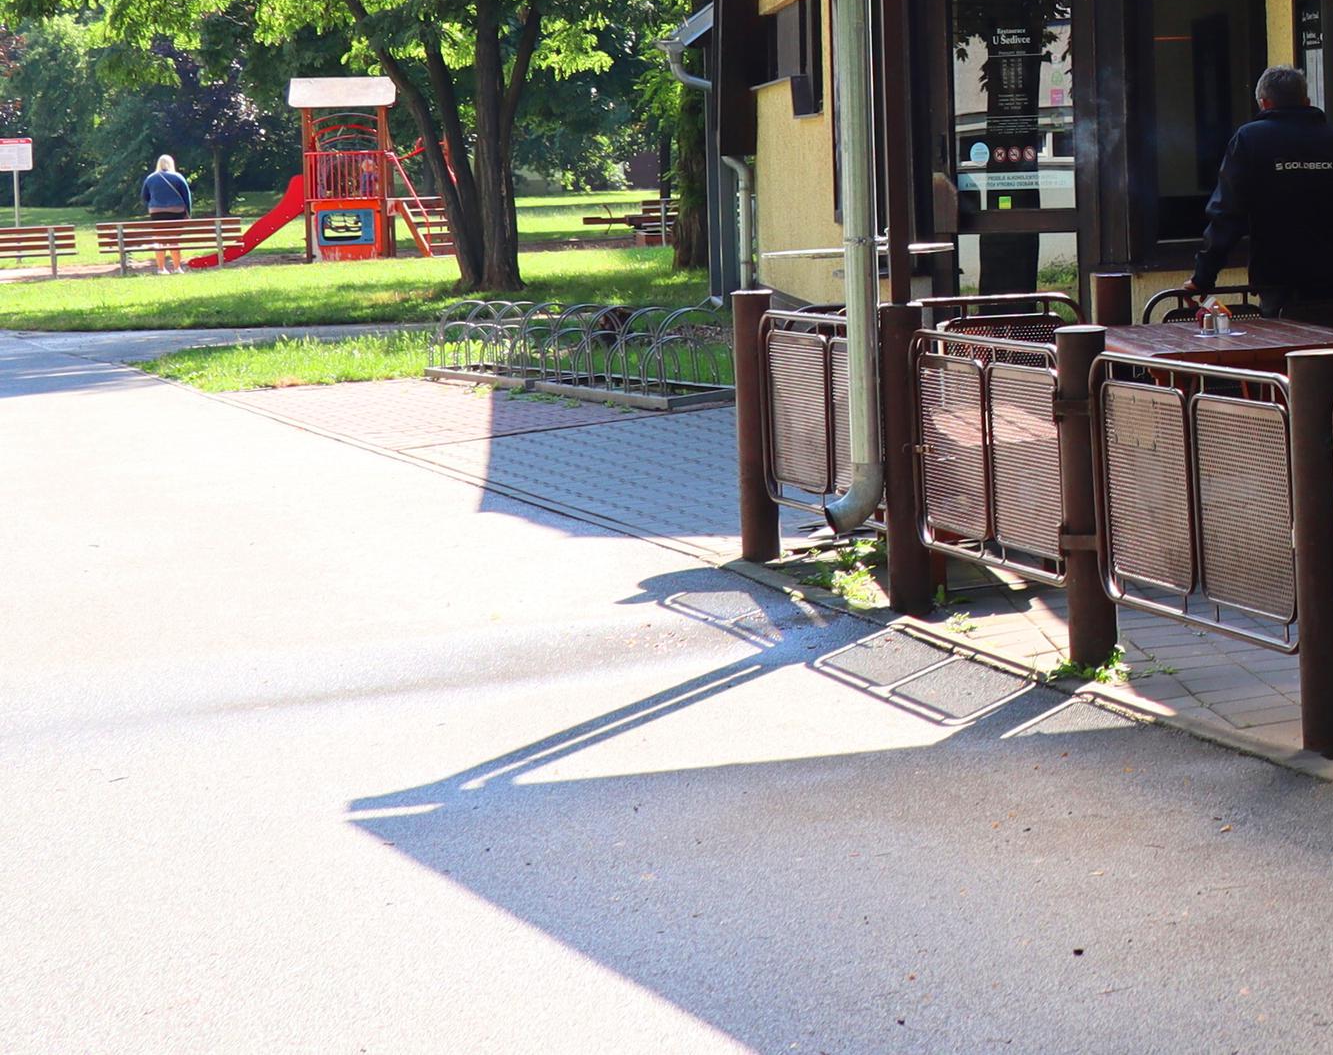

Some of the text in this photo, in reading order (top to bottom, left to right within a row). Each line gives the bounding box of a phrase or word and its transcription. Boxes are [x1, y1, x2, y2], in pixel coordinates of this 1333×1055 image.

[992, 34, 1031, 45] U Šedivce
[1284, 162, 1333, 170] GOLDBECK
